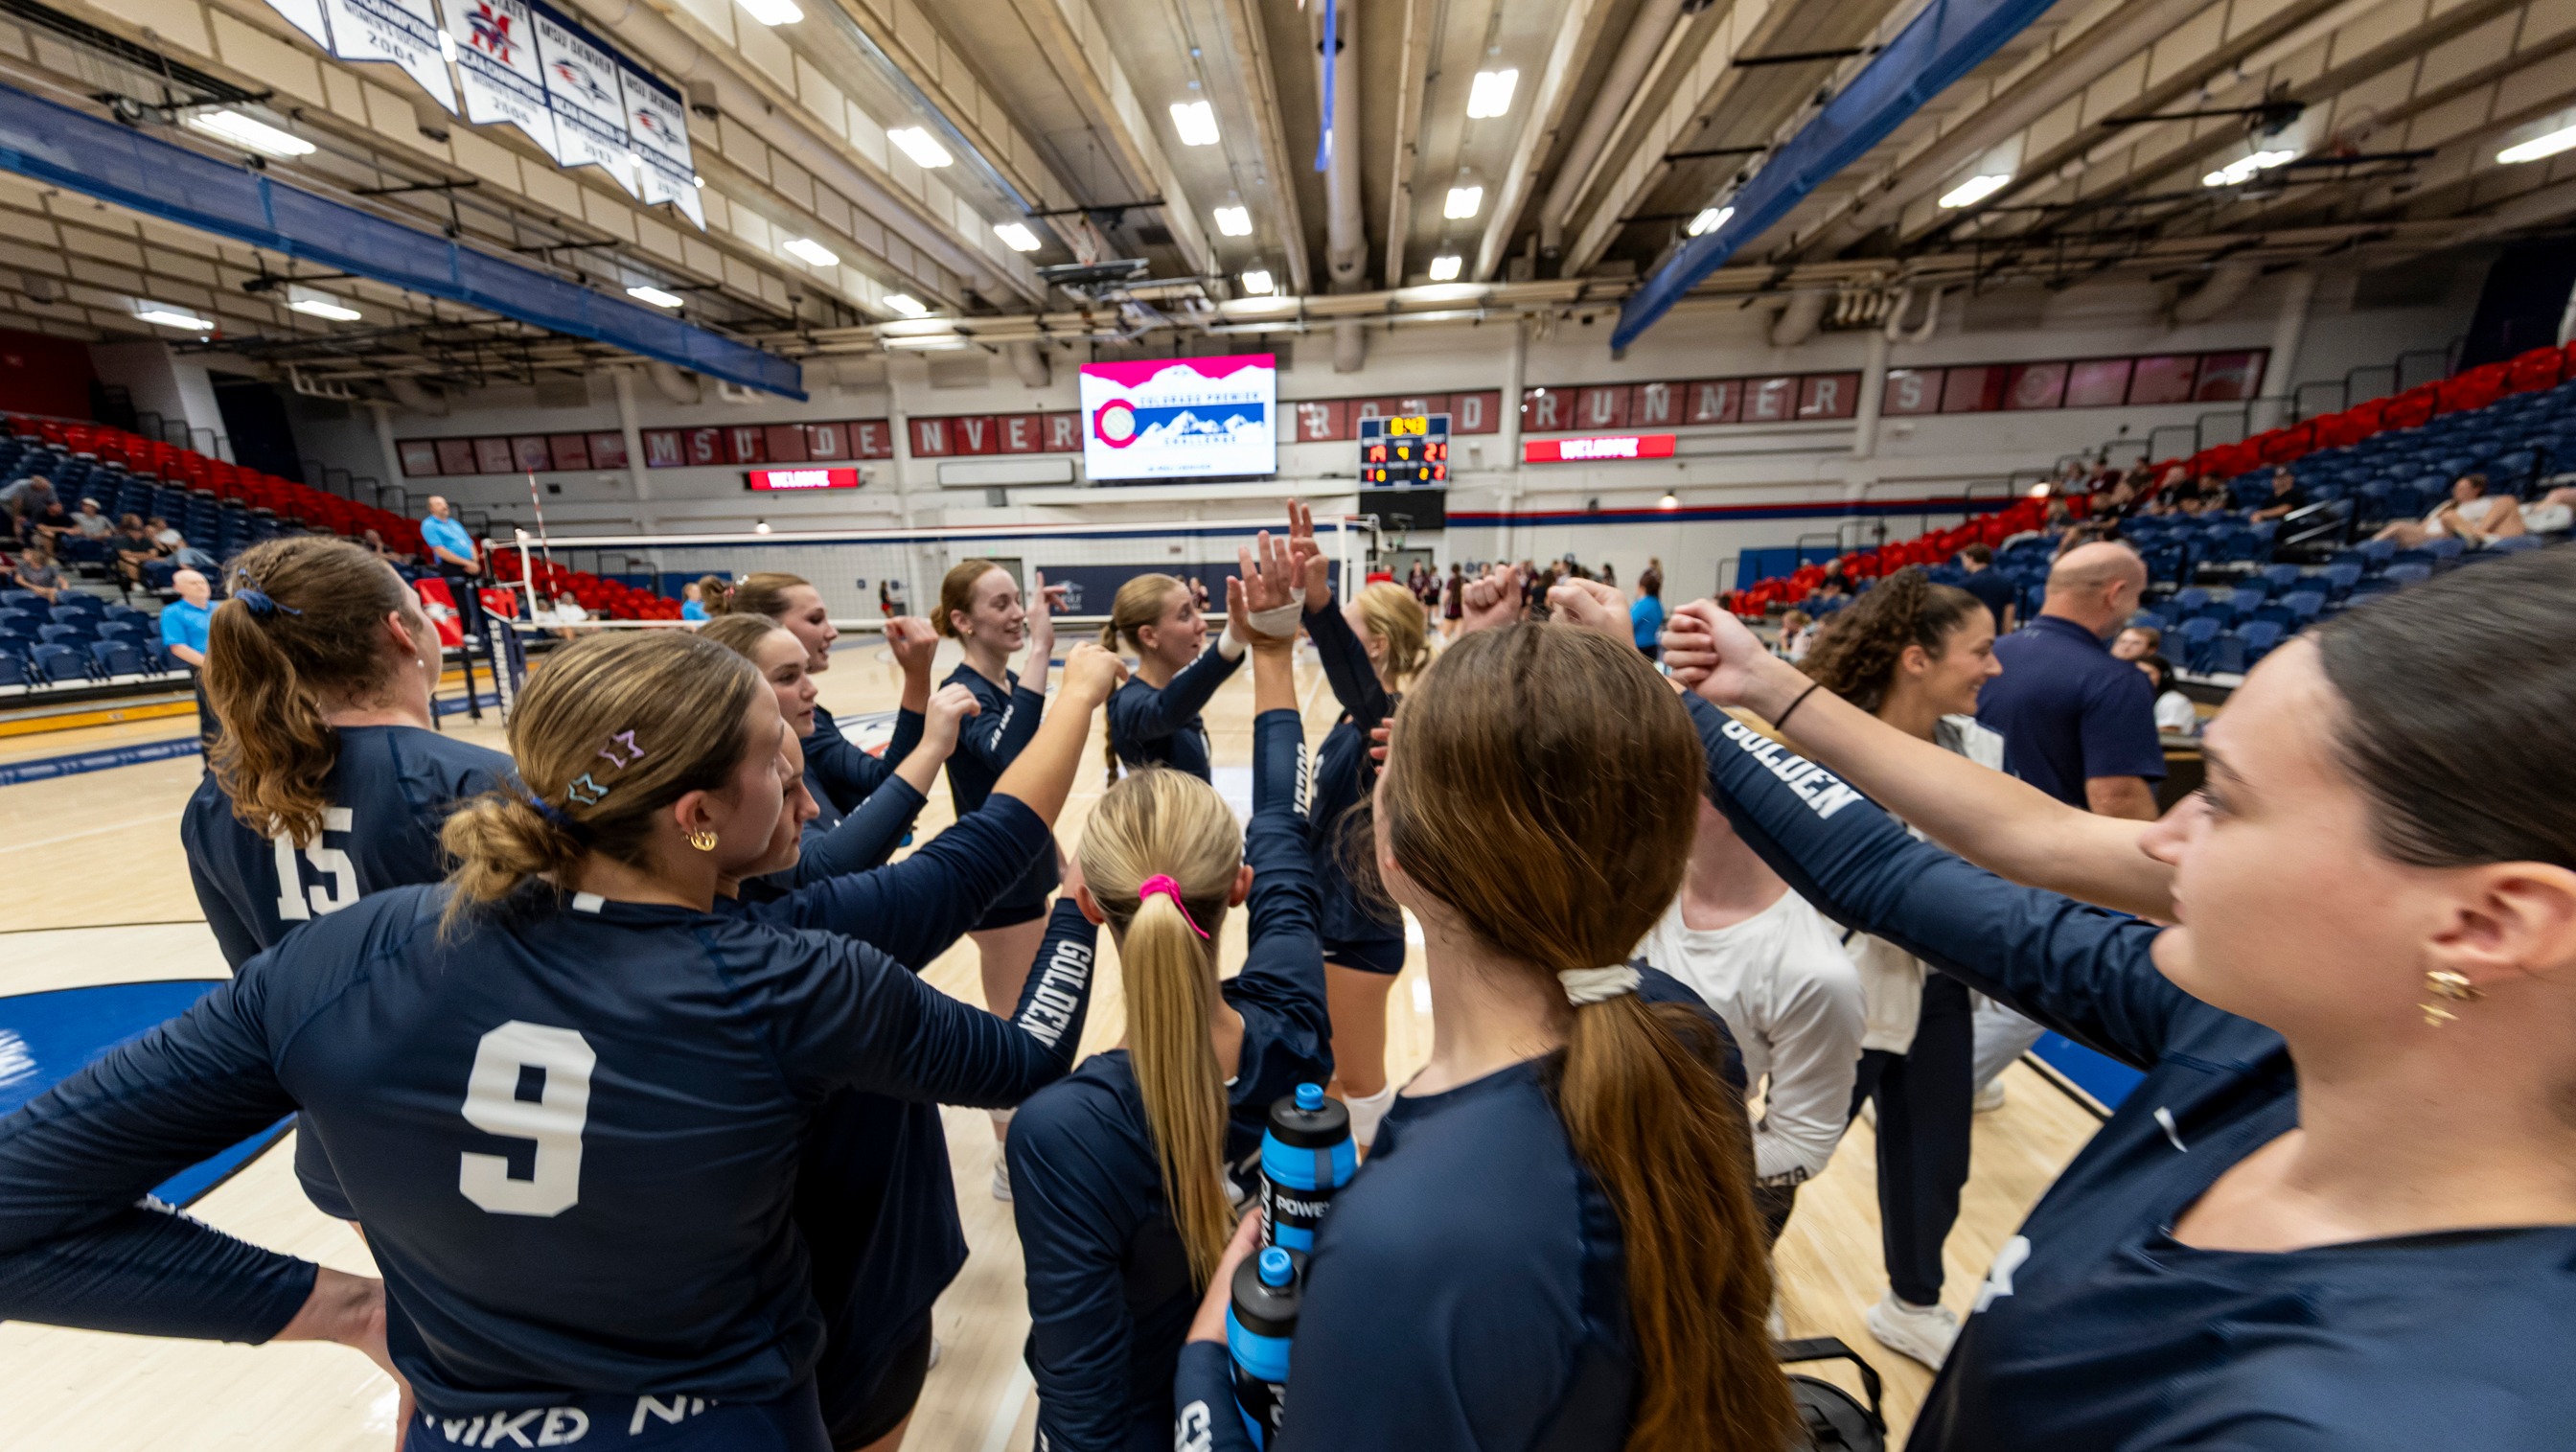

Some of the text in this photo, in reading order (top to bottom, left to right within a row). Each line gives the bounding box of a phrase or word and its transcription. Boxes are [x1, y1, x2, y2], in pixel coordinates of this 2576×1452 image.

[368, 31, 417, 66] 2004
[540, 21, 611, 76] MSU DENVER
[1139, 395, 1202, 408] COLORADO
[650, 416, 1075, 463] MSU DENVER
[1424, 442, 1447, 462] 21
[1721, 719, 1865, 820] GOLDEN
[268, 806, 361, 921] 15
[1017, 939, 1093, 1049] GOLDEN
[459, 1019, 597, 1218] 9
